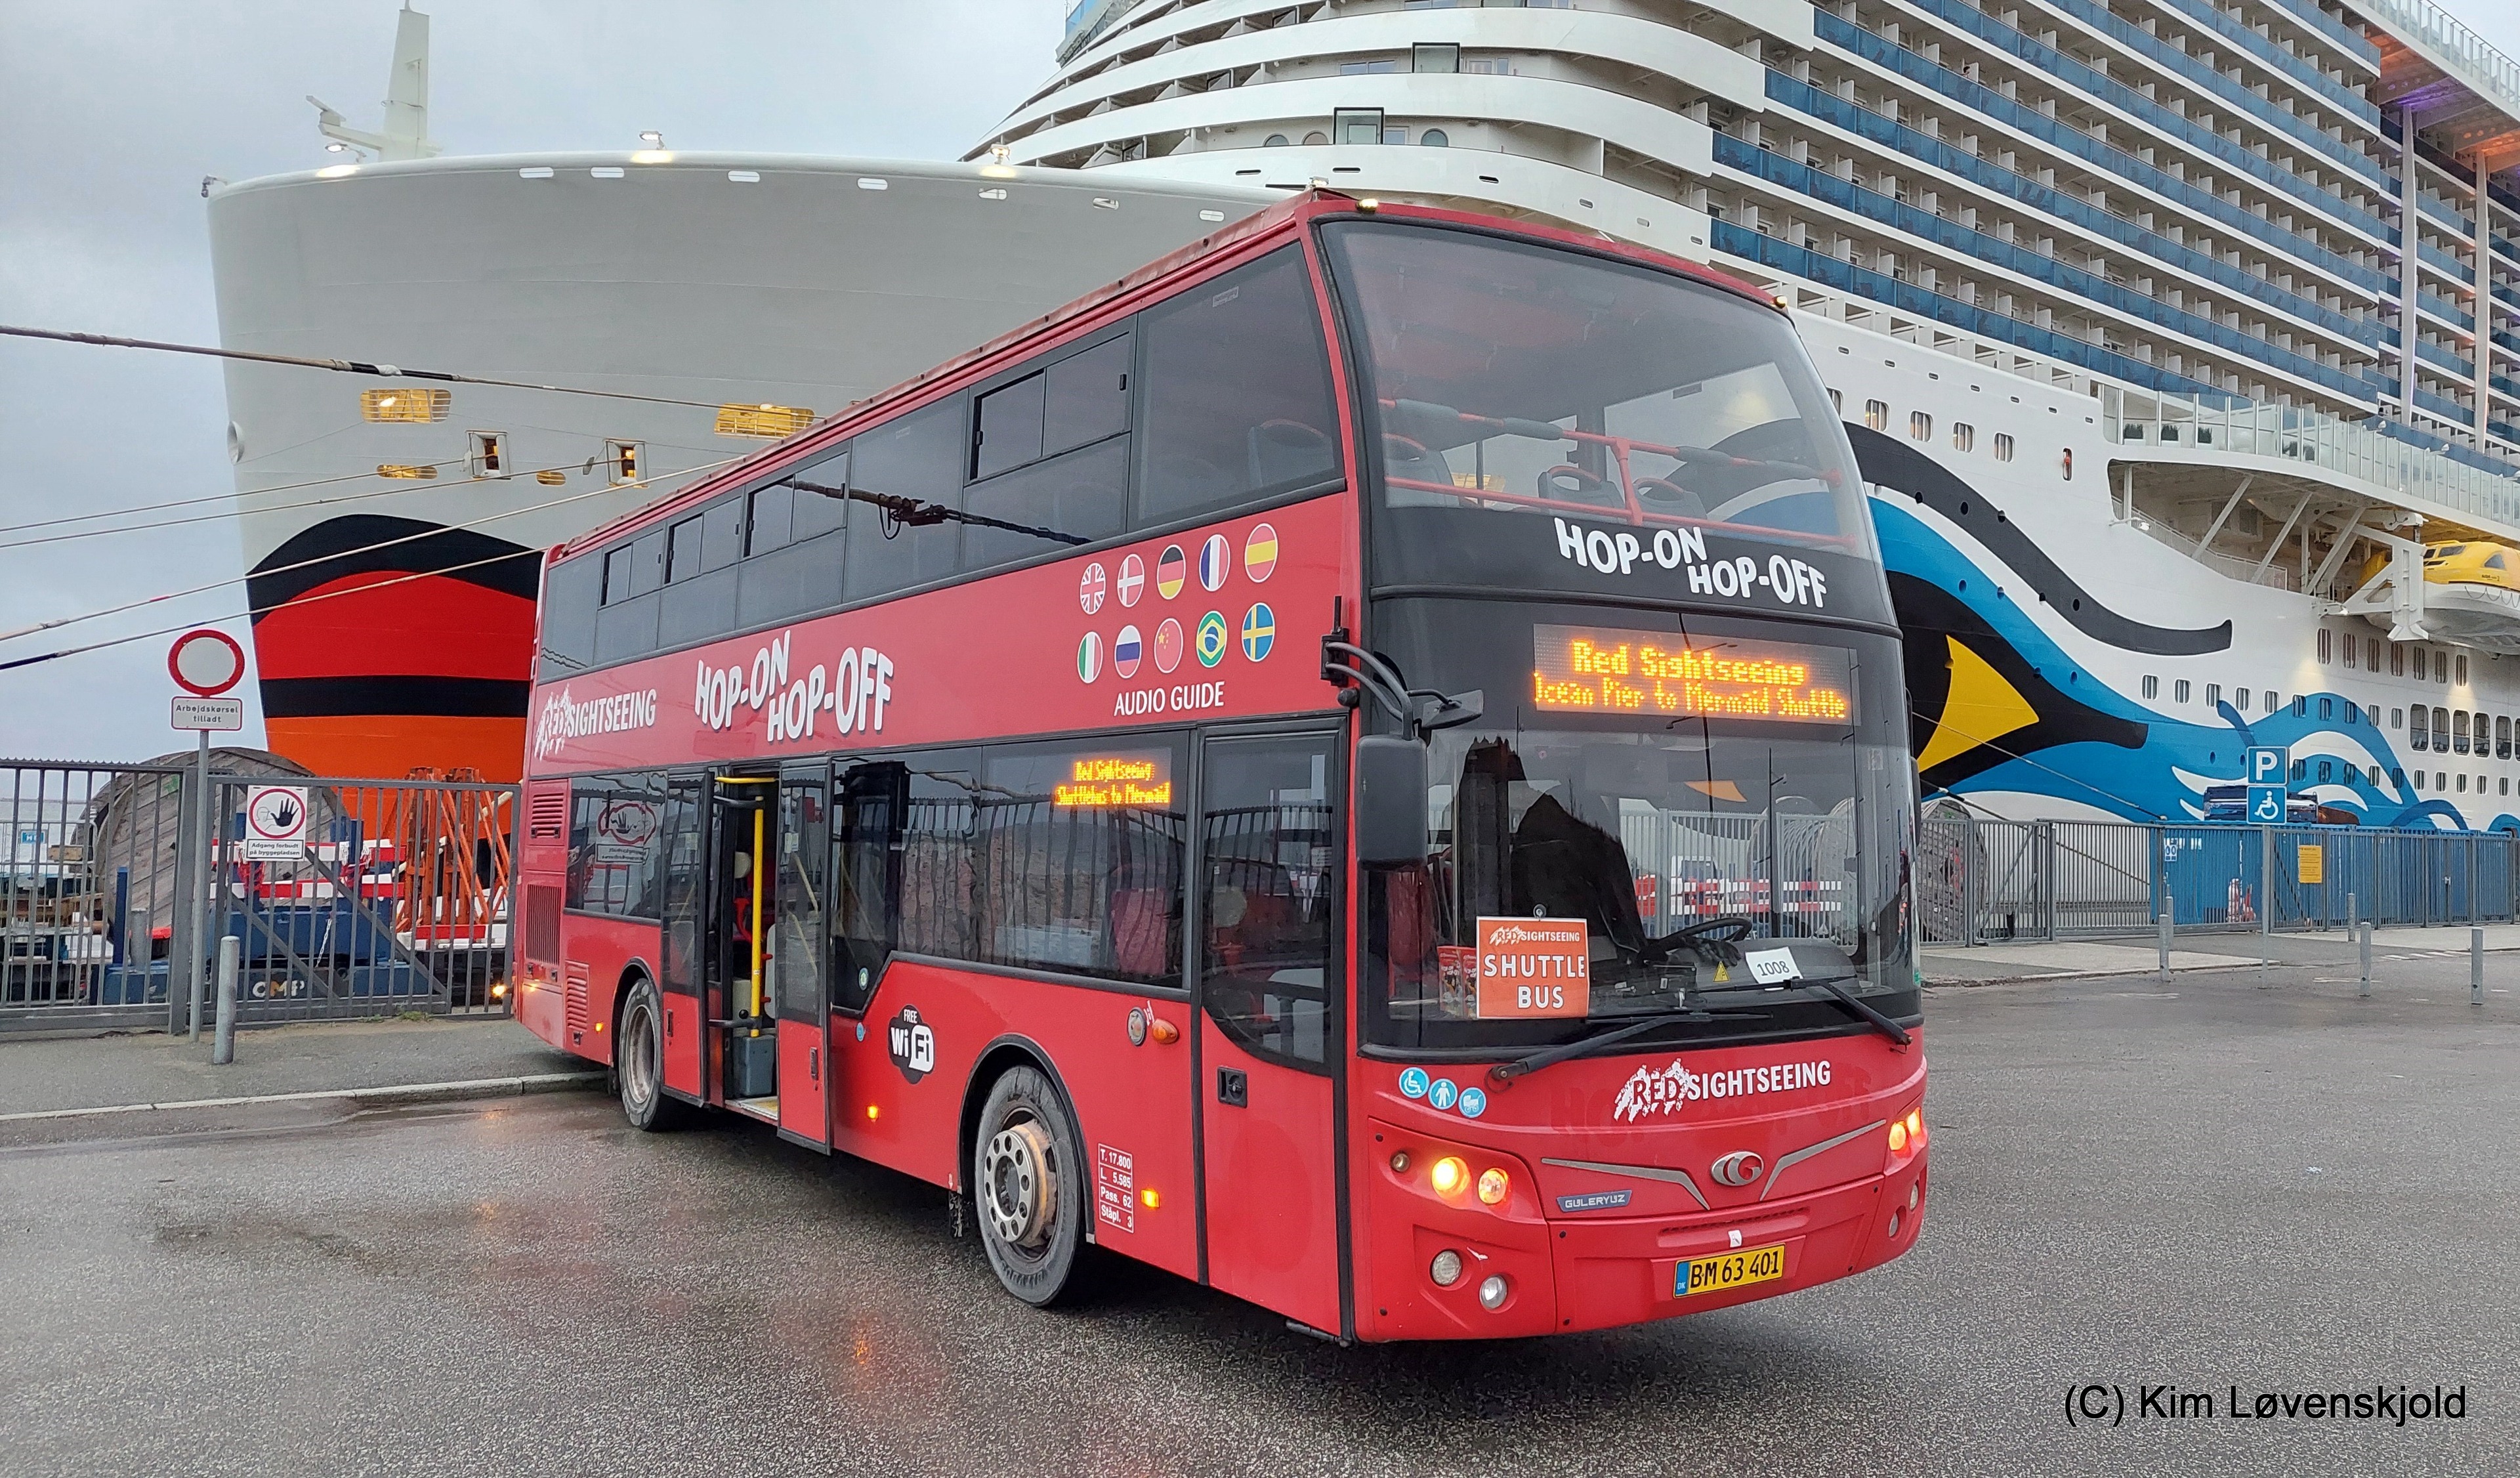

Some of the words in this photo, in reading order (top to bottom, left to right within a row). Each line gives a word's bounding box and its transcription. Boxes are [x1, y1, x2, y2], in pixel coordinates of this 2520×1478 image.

[1554, 517, 1708, 575] HOP-ON
[1687, 554, 1828, 608] HOP-OFF
[1572, 641, 1629, 676] Red
[1639, 646, 1805, 686] Sightseeing
[694, 629, 791, 730] HOP-ON
[766, 646, 894, 742] HOP-OFF
[1113, 687, 1166, 717] AUDIO
[1170, 681, 1225, 711] GUIDE
[1603, 676, 1645, 707] Pier
[1655, 680, 1677, 709] to
[1685, 681, 1771, 715] Mermaid
[1776, 687, 1845, 719] Shuttle
[175, 704, 238, 713] Arbejdskørsel
[2256, 751, 2278, 780] P
[1483, 954, 1586, 978] SHUTTLE
[1757, 960, 1790, 977] 1008
[1517, 985, 1564, 1009] BUS
[903, 1009, 917, 1024] FREE
[1100, 1148, 1108, 1162] T.
[1108, 1151, 1131, 1170] 17.800
[1100, 1167, 1108, 1181] L.
[1112, 1171, 1131, 1189] 5.585
[1100, 1185, 1120, 1204] Pass.
[1122, 1194, 1132, 1208] 62
[1101, 1204, 1122, 1223] Ståpl.
[1127, 1215, 1133, 1228] 3
[1690, 1261, 1718, 1289] BM
[1721, 1257, 1744, 1283] 63
[1749, 1250, 1779, 1278] 401
[1677, 1282, 1686, 1290] DK
